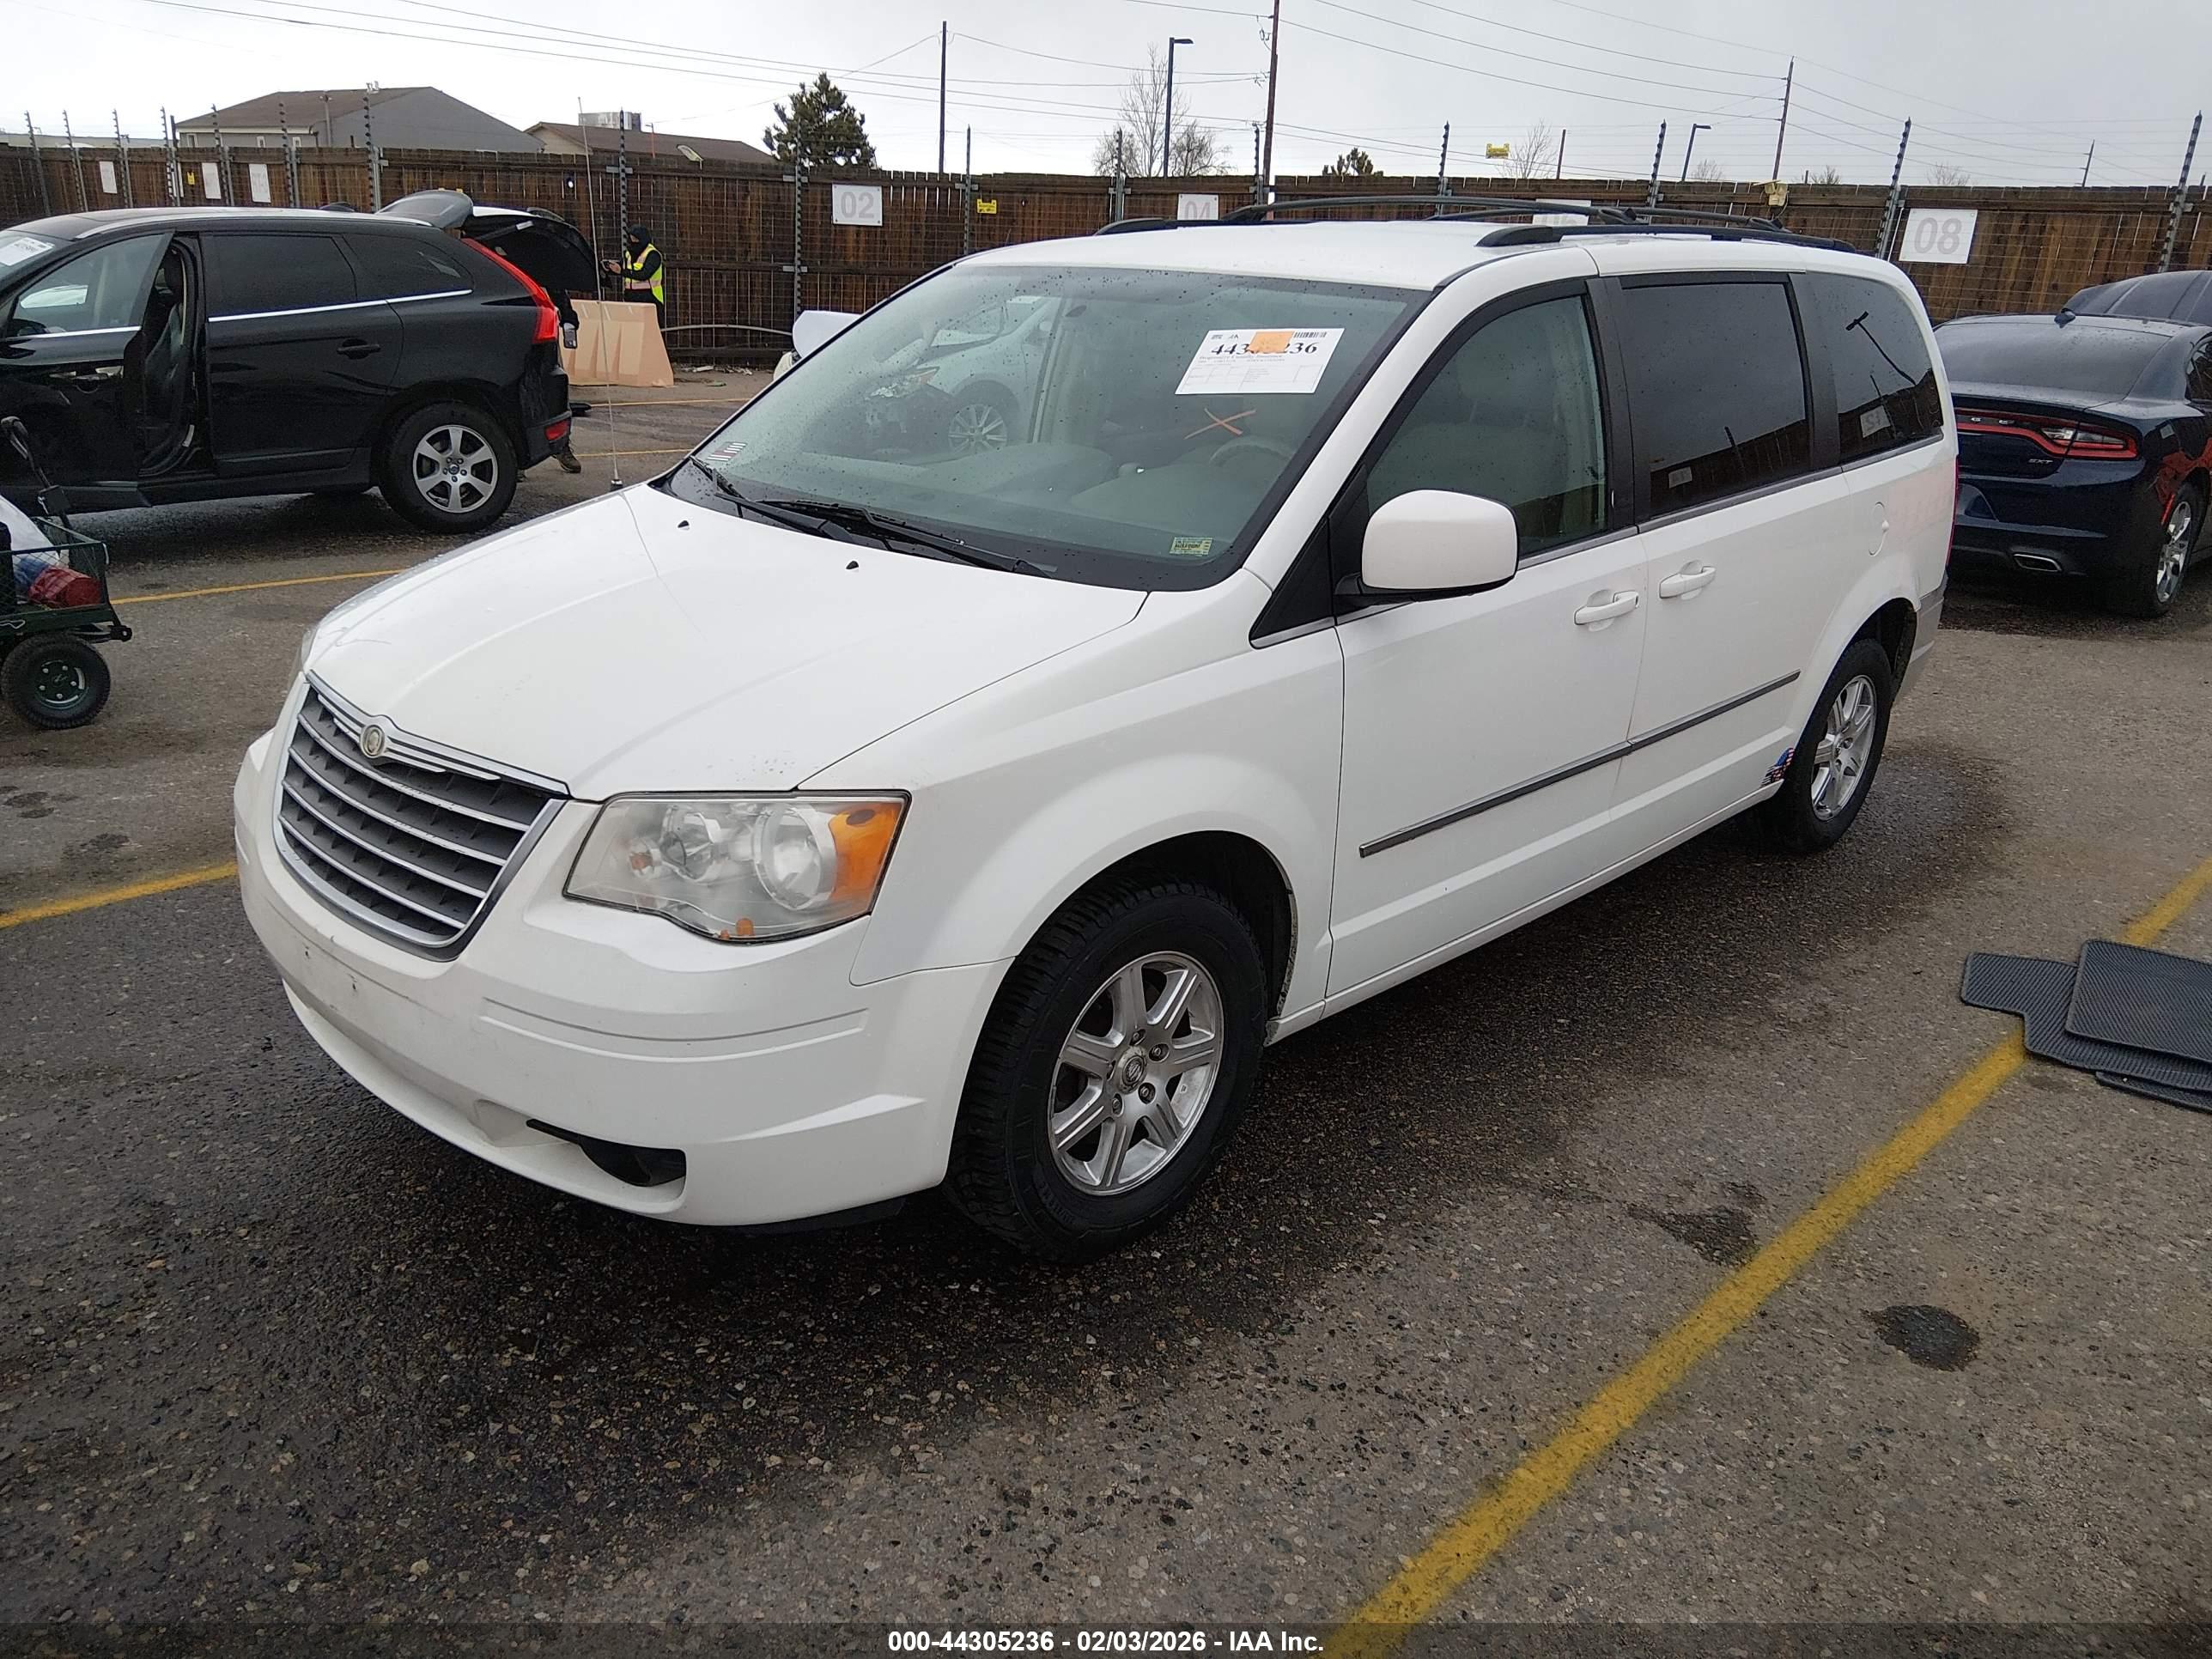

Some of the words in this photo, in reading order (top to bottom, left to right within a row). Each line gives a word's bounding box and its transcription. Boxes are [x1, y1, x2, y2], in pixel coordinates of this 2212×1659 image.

[840, 191, 874, 218] 02
[1914, 217, 1962, 254] 08
[1211, 342, 1320, 356] 44336
